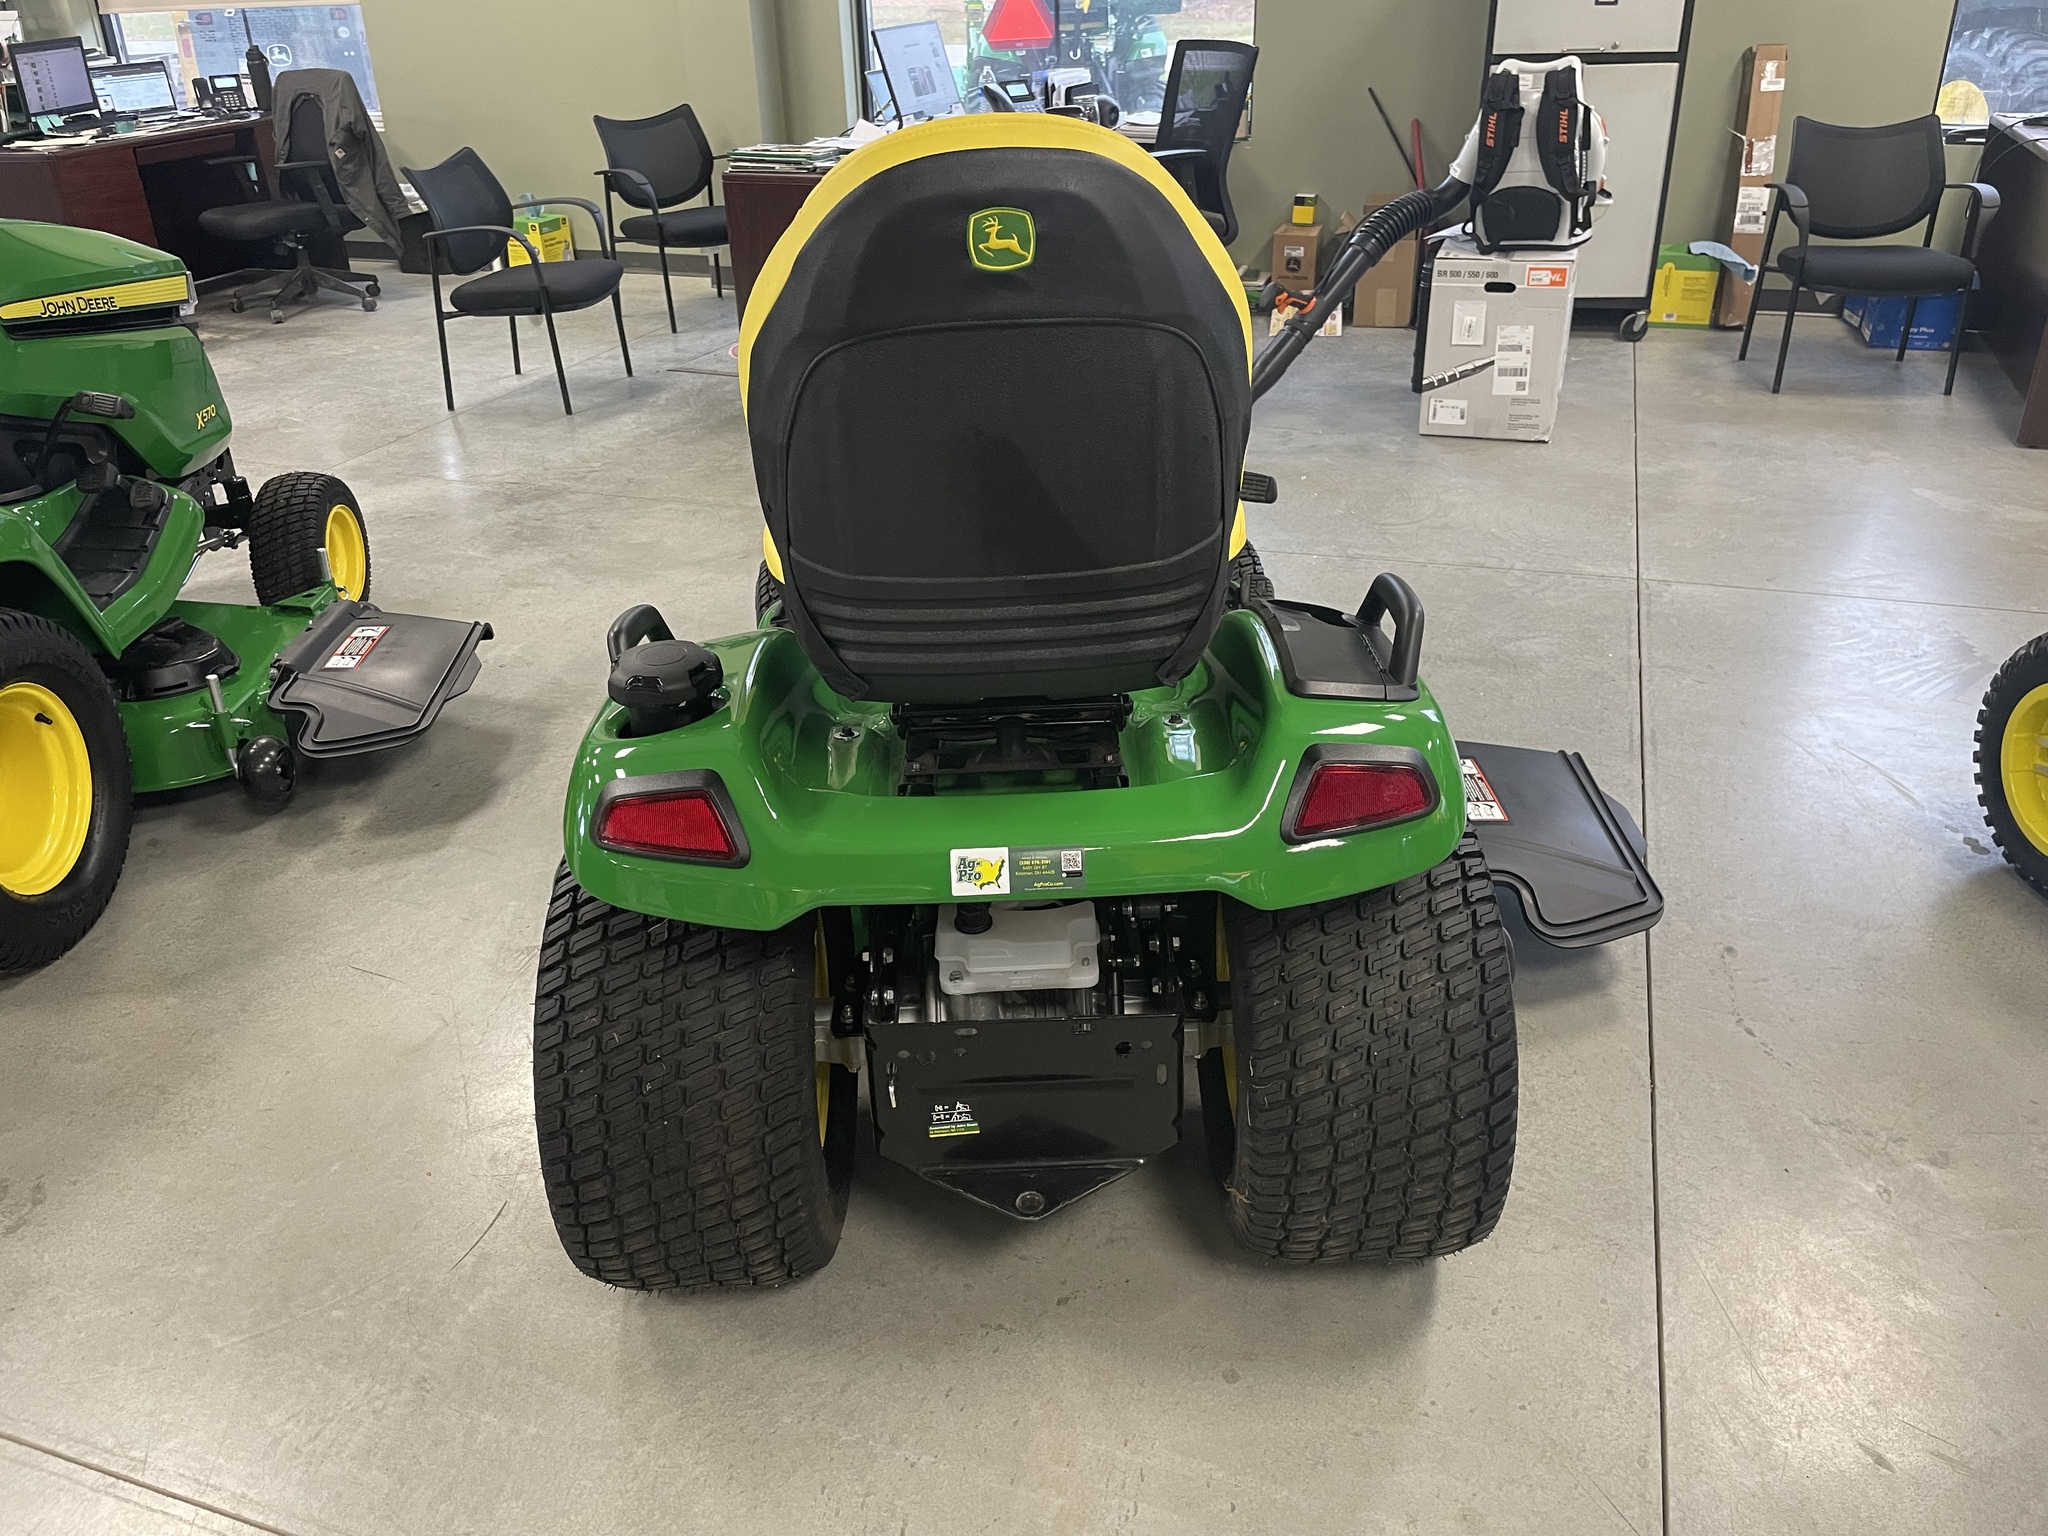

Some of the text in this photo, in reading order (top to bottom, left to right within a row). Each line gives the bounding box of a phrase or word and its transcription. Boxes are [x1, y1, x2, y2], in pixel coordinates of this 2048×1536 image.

[1486, 112, 1498, 148] STIHL
[1559, 108, 1569, 144] STIHL
[1437, 269, 1448, 278] BR
[1449, 270, 1462, 278] 500
[1467, 270, 1480, 279] 550
[40, 296, 118, 317] JOHN DEERE
[195, 404, 217, 430] X570
[958, 870, 982, 882] Pro
